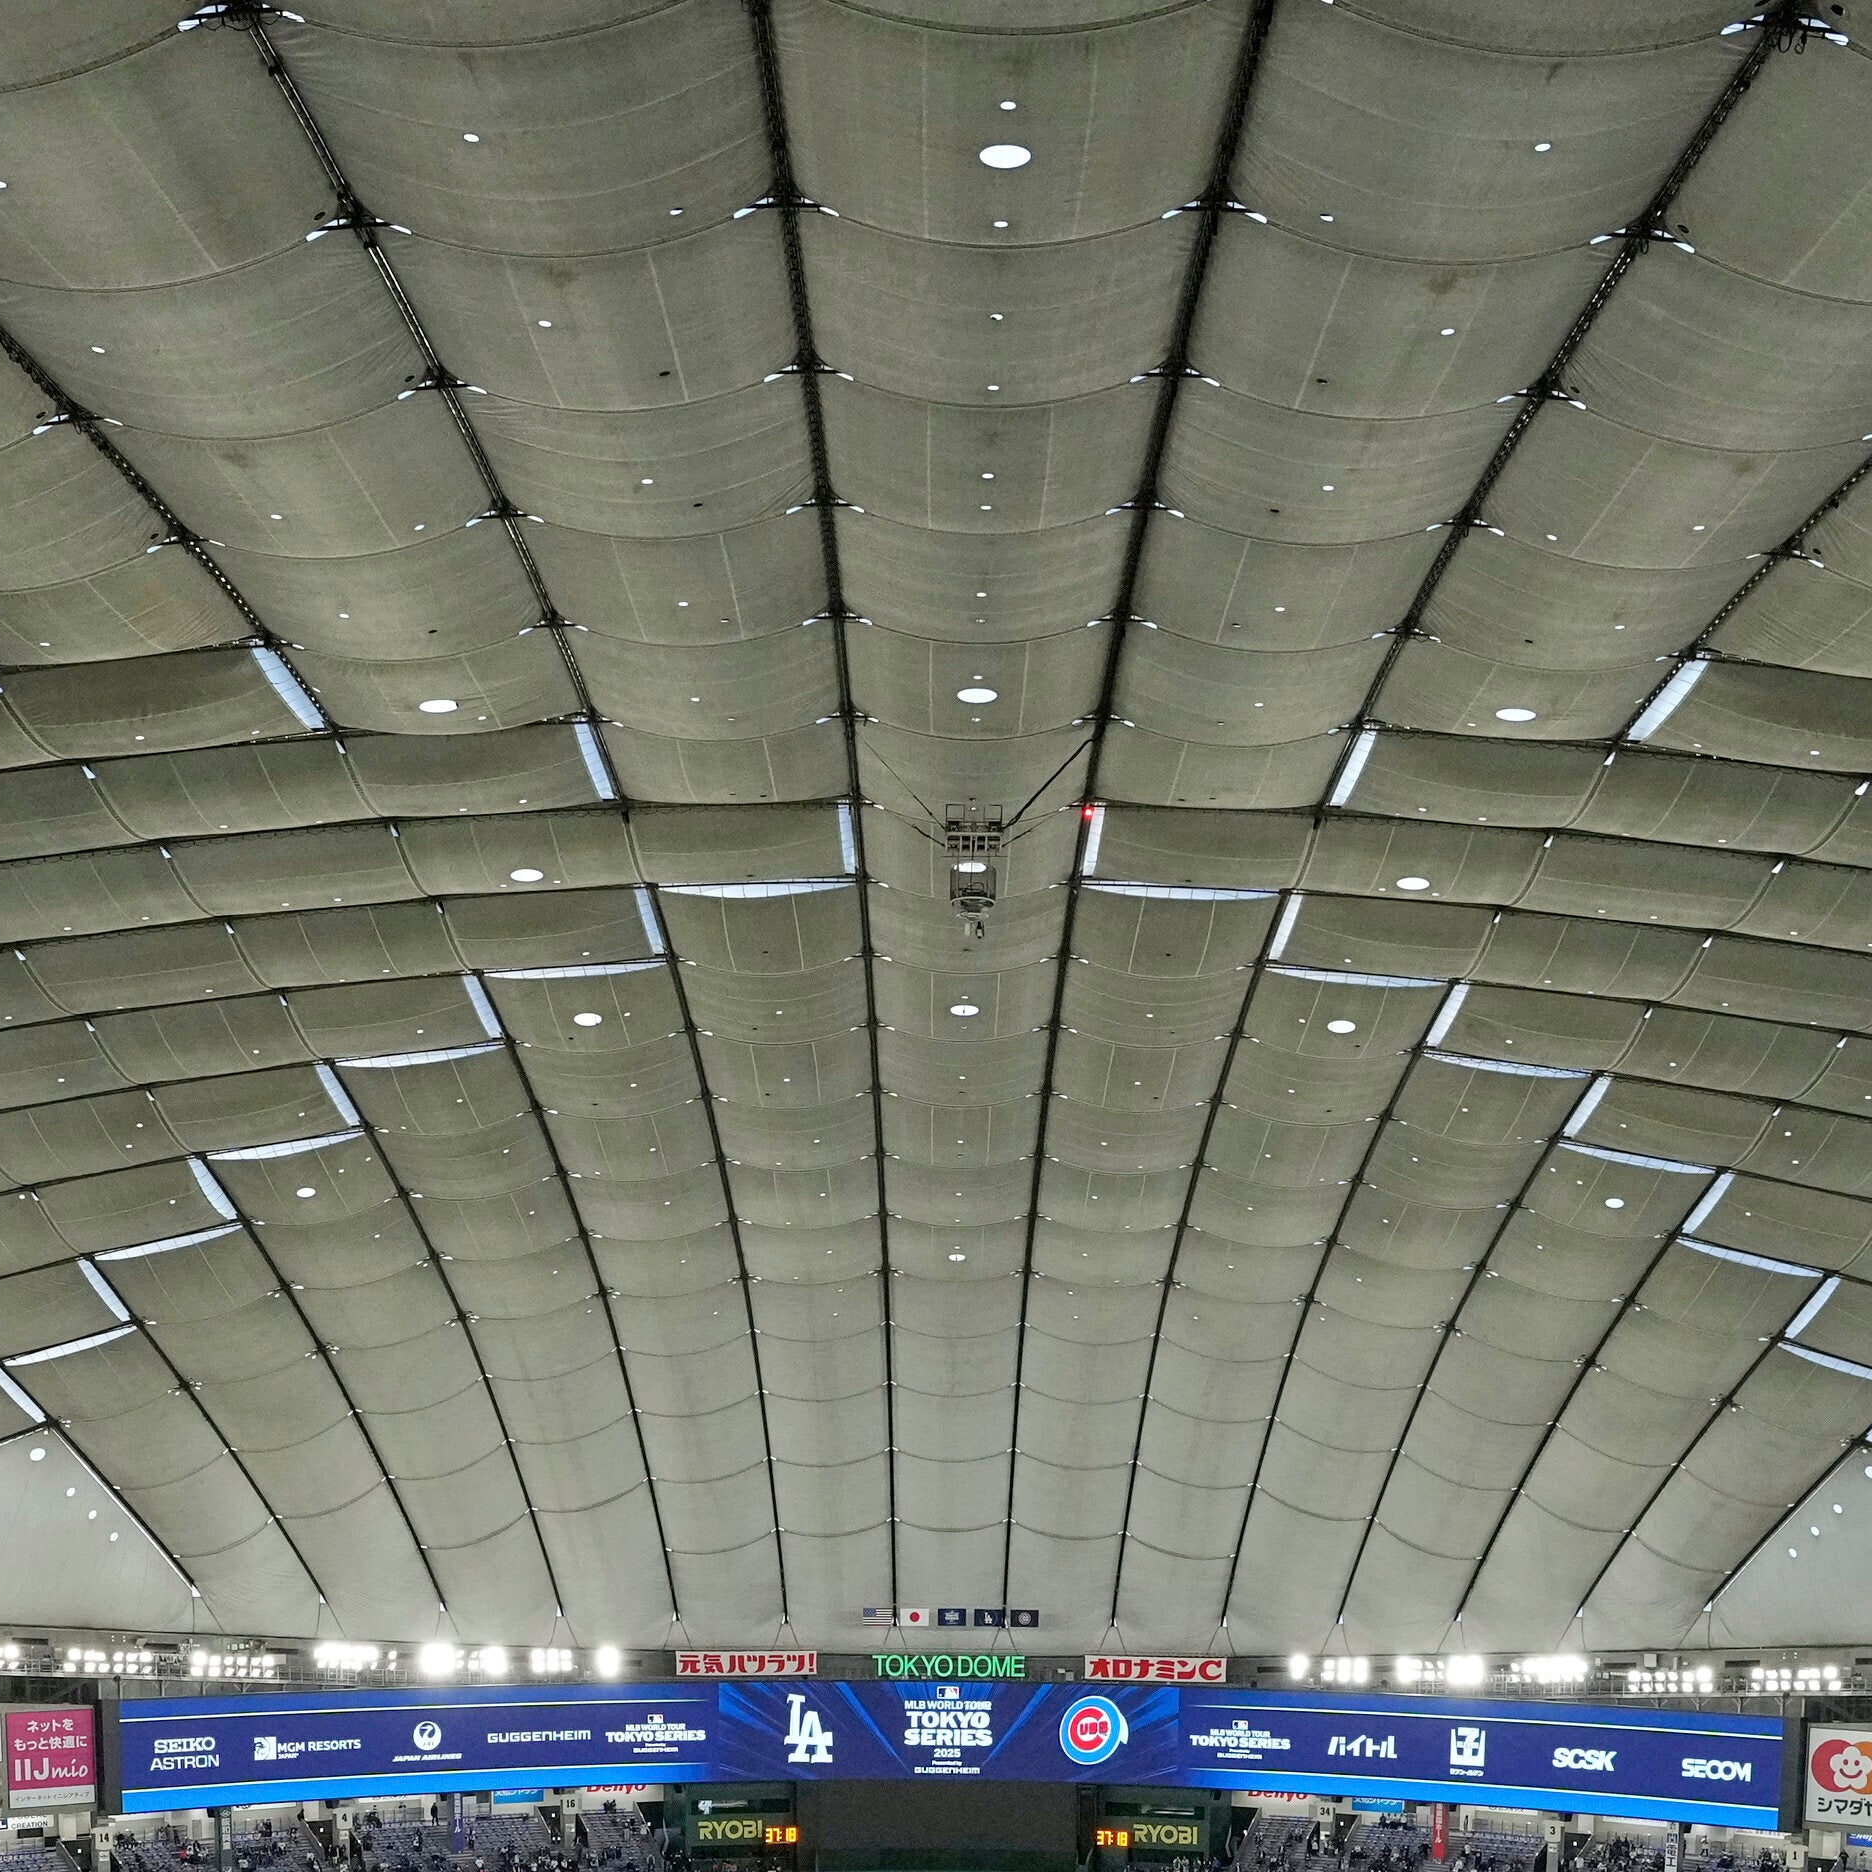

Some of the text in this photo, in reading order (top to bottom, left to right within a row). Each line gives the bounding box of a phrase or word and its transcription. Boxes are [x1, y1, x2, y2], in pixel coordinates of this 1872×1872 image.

[872, 1654, 1026, 1678] TOKYO DOME
[1089, 1659, 1222, 1682] オロナミンC
[904, 1700, 992, 1711] MLB WORLD TOUR
[26, 1718, 75, 1733] ネットを
[906, 1711, 991, 1728] TOKYO
[625, 1723, 685, 1732] MLB WORLD TOUR
[784, 1693, 834, 1764] LA
[1210, 1729, 1271, 1739] MLB WORLD TOUR
[14, 1735, 88, 1751] もっと快適に
[487, 1730, 591, 1744] GUGGENHEIM
[605, 1729, 706, 1744] TOKYO SERIES
[904, 1729, 993, 1746] SERIES
[1190, 1735, 1291, 1750] TOKYO SERIES
[153, 1737, 216, 1754] SEIKO
[277, 1739, 361, 1753] MGM RESORTS
[933, 1748, 961, 1758] 2025
[1327, 1734, 1398, 1759] バイトル
[150, 1754, 220, 1771] ASTRON
[392, 1752, 463, 1763] JAPAN AIRLINES
[1552, 1747, 1617, 1772] SCSK
[1681, 1758, 1752, 1782] SECOM
[566, 1799, 576, 1808] 16
[341, 1814, 347, 1822] 4
[1320, 1807, 1330, 1816] 34
[11, 1820, 48, 1829] CREATION
[698, 1819, 763, 1840] RYOBI
[1549, 1826, 1556, 1835] 3
[100, 1834, 109, 1842] 14
[765, 1827, 797, 1844] 37:18
[1096, 1831, 1128, 1847] 37:18
[1133, 1823, 1199, 1845] RYOBI
[1792, 1851, 1797, 1860] 1
